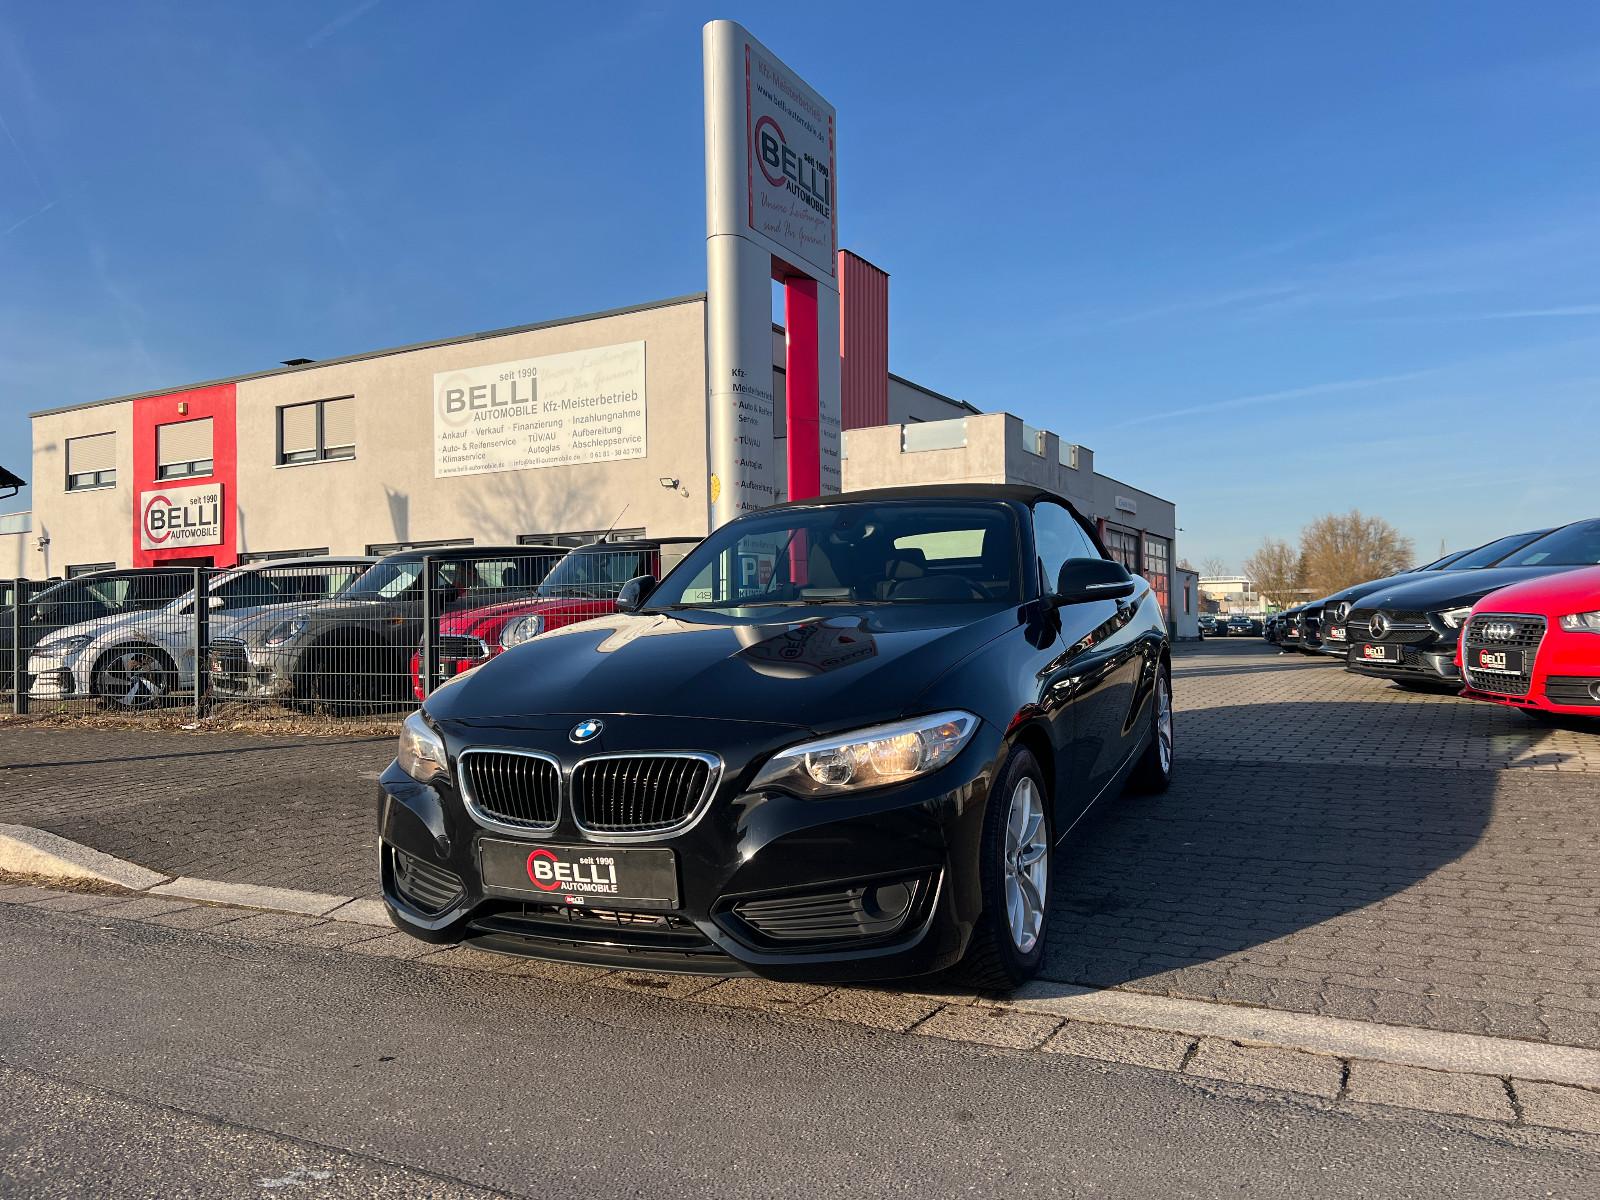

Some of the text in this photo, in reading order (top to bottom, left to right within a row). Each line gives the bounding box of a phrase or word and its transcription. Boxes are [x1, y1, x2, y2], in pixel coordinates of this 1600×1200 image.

[762, 130, 829, 206] BELLI
[804, 153, 828, 178] seit 1990
[786, 180, 830, 220] AUTOMOBILE
[500, 367, 537, 382] seit 1990
[732, 368, 748, 378] Kfz-
[446, 377, 538, 414] BELLI
[543, 390, 638, 413] Kfz-Meisterbetrieb
[442, 409, 641, 440] Ankauf Verkauf Finanzierung Inzahlungnahme
[474, 404, 538, 422] AUTOMOBILE
[442, 434, 642, 464] Klimaservice Autoglas Abschleppservice
[469, 438, 516, 450] Reifenservice
[528, 432, 556, 443] TÜV/AU
[572, 425, 622, 439] Aufbereitung
[190, 494, 218, 505] seit 1990
[151, 504, 217, 530] BELLI
[171, 526, 217, 539] AUTOMOBILE
[1482, 652, 1506, 664] BELLI
[534, 860, 617, 884] BELLI
[580, 857, 614, 865] seit 1990
[561, 882, 618, 893] AUTOMOBILE
